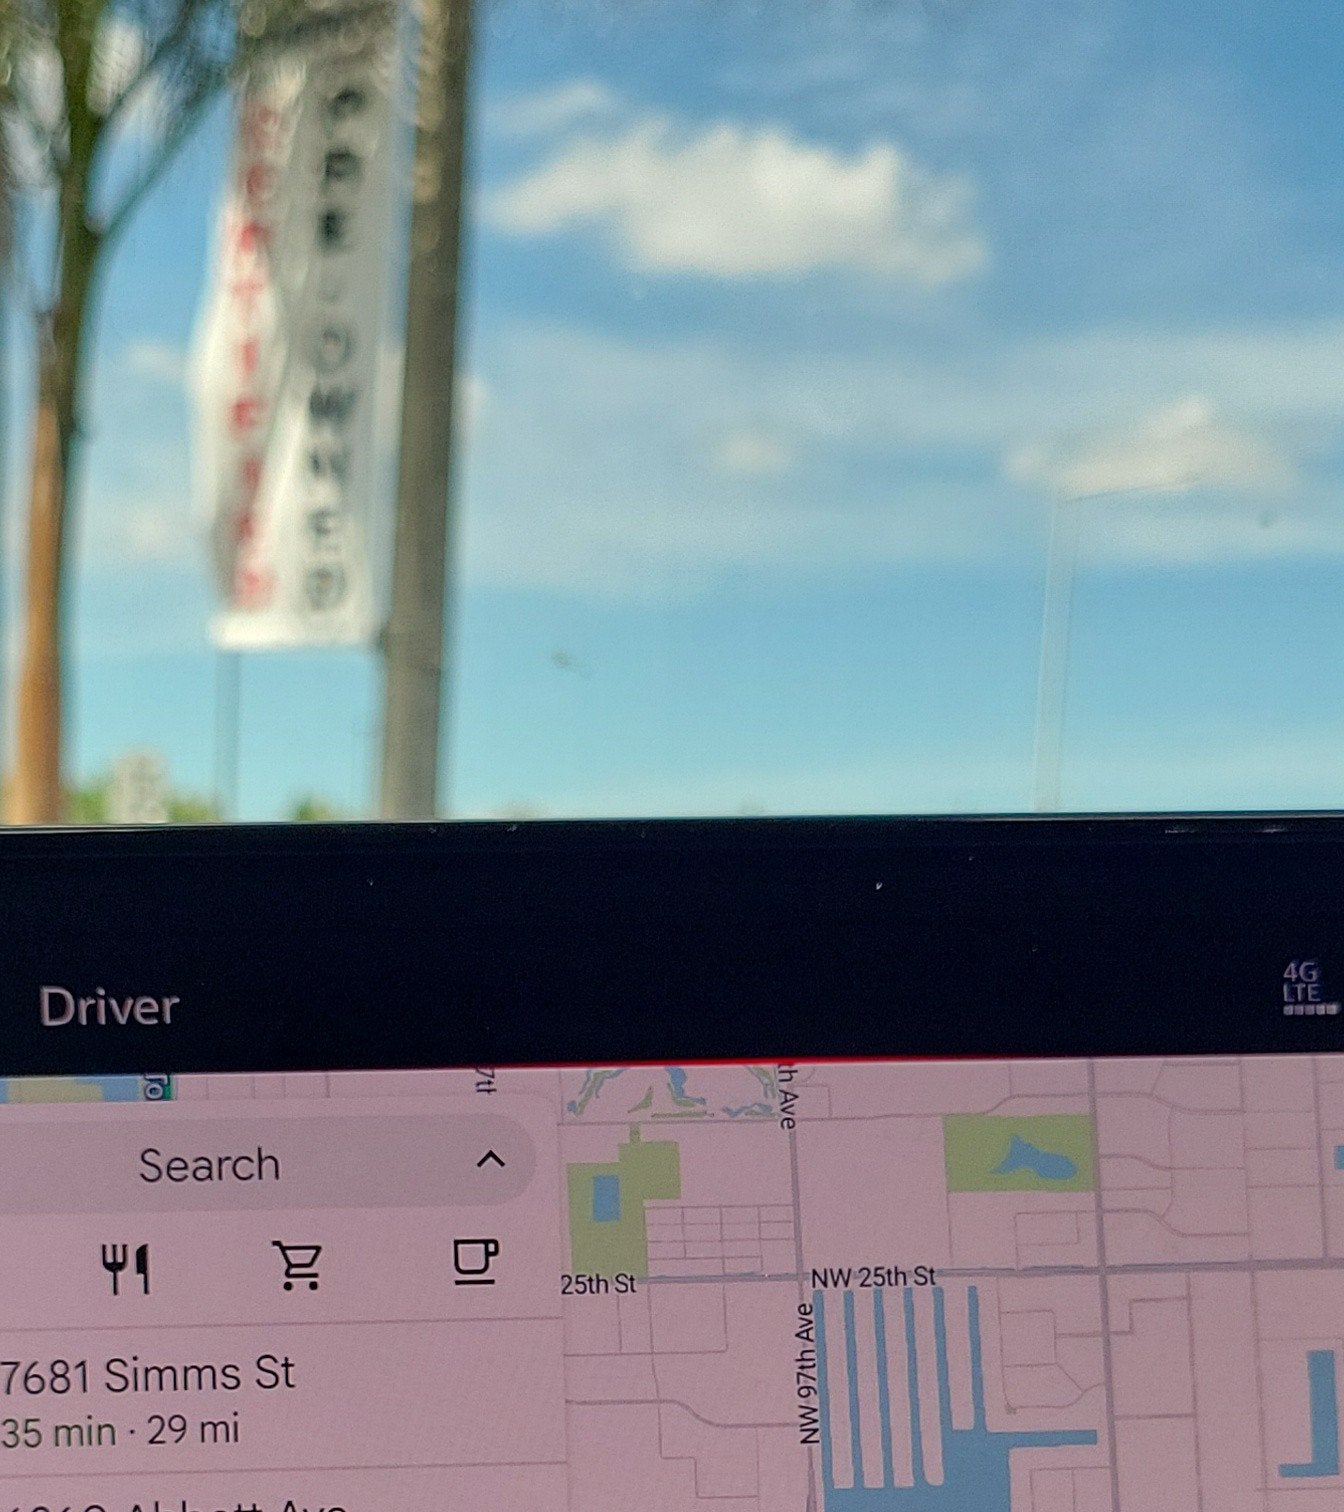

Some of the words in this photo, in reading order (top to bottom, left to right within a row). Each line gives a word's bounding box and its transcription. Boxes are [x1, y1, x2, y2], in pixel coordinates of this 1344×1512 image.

[1283, 961, 1319, 982] 4G
[39, 986, 180, 1027] Driver
[1283, 983, 1321, 1002] LTE
[779, 1089, 799, 1130] Ave
[139, 1147, 280, 1182] Search
[561, 1274, 608, 1295] 25th
[614, 1274, 636, 1294] St
[812, 1269, 852, 1289] NW
[859, 1267, 907, 1288] 25th
[913, 1266, 936, 1285] St
[795, 1303, 815, 1342] Ave
[0, 1359, 90, 1395] 7681
[105, 1356, 241, 1393] Simms
[255, 1354, 296, 1390] St
[796, 1348, 818, 1400] 97th
[1, 1417, 43, 1448] 35
[54, 1416, 116, 1447] min
[147, 1414, 188, 1444] 29
[200, 1412, 240, 1443] mi
[800, 1404, 819, 1444] NW
